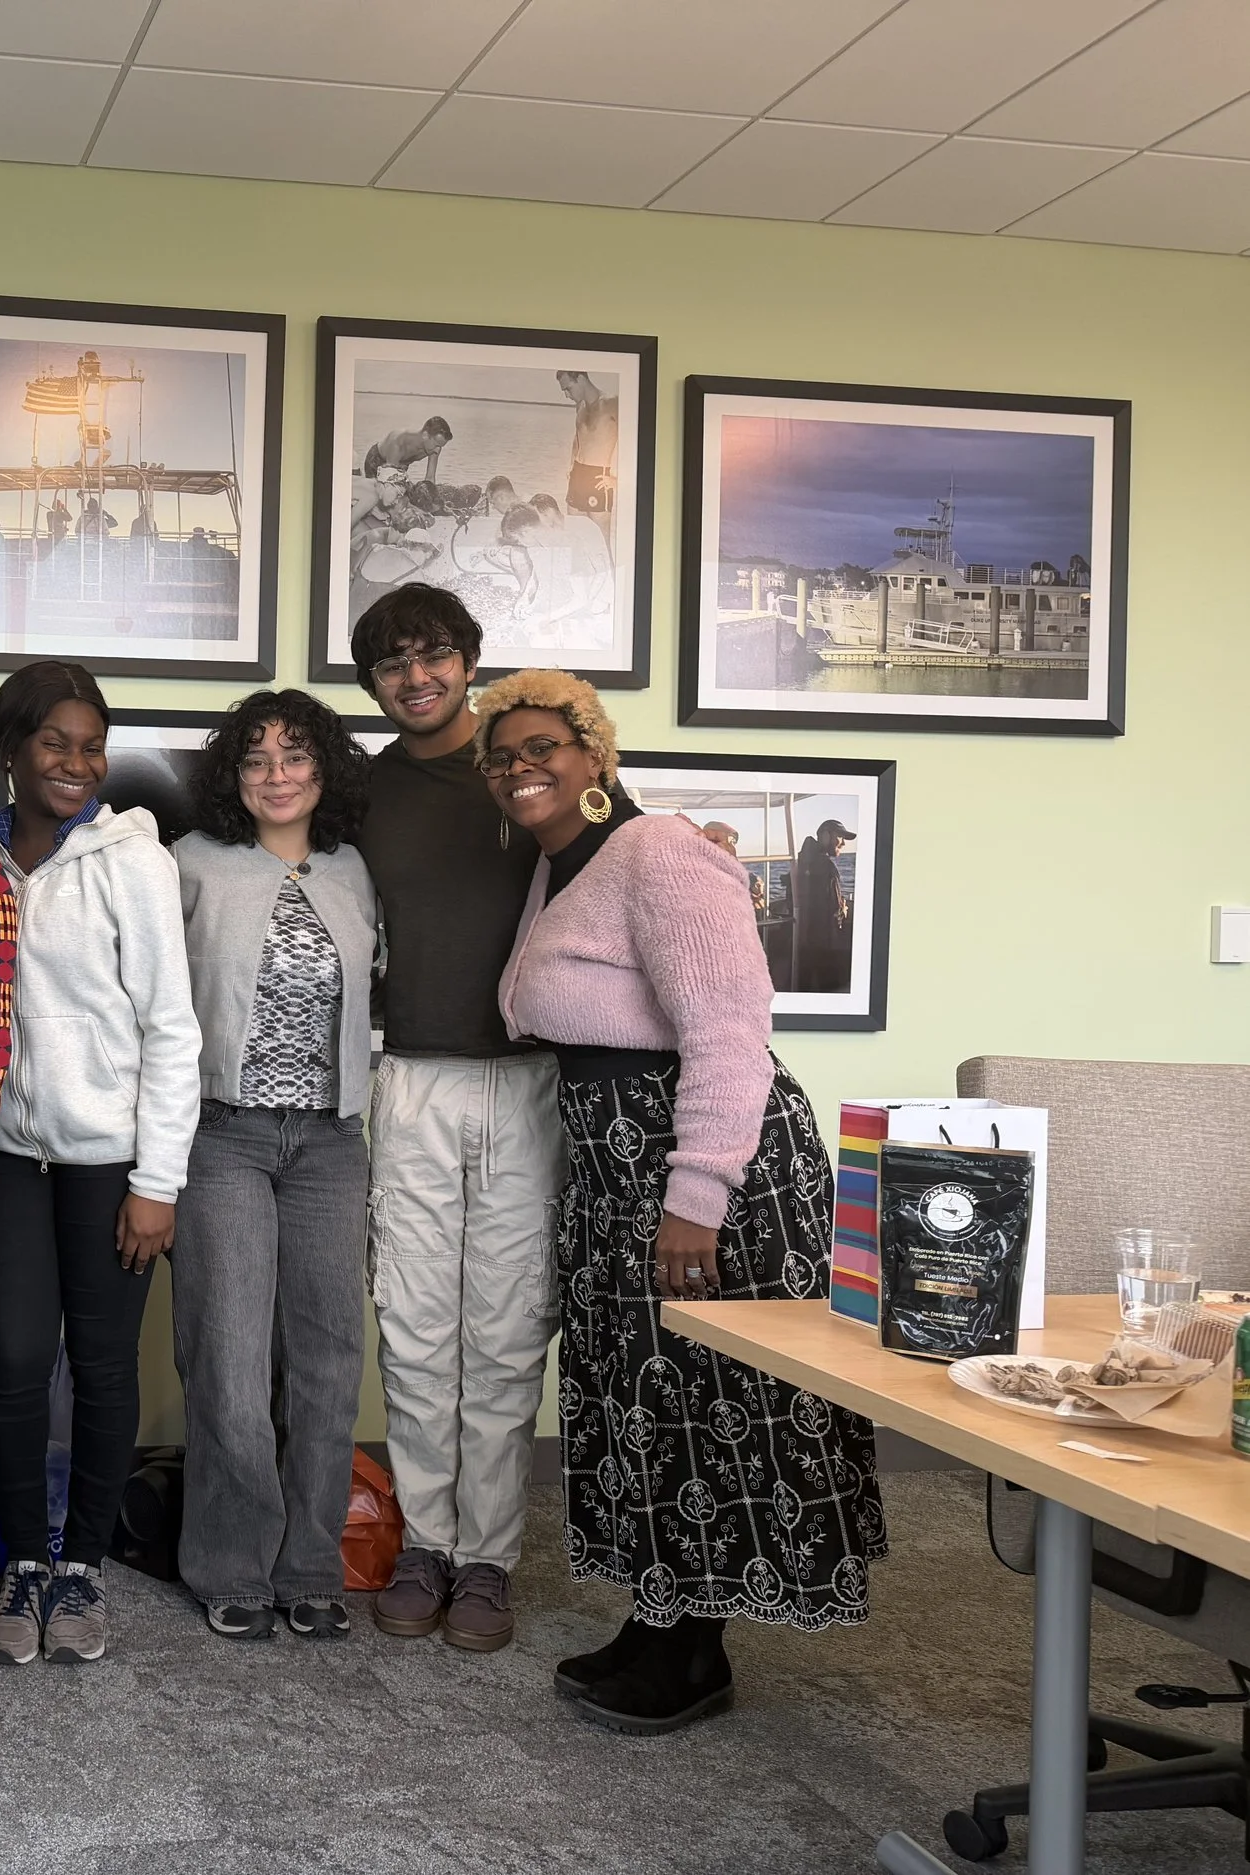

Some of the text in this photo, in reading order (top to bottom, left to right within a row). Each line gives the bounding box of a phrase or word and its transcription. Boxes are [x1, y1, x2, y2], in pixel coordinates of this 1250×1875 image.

[925, 1186, 979, 1206] CAFÉ XIOJANA
[944, 1250, 963, 1258] Puerto
[924, 1272, 969, 1284] Tueste Medio
